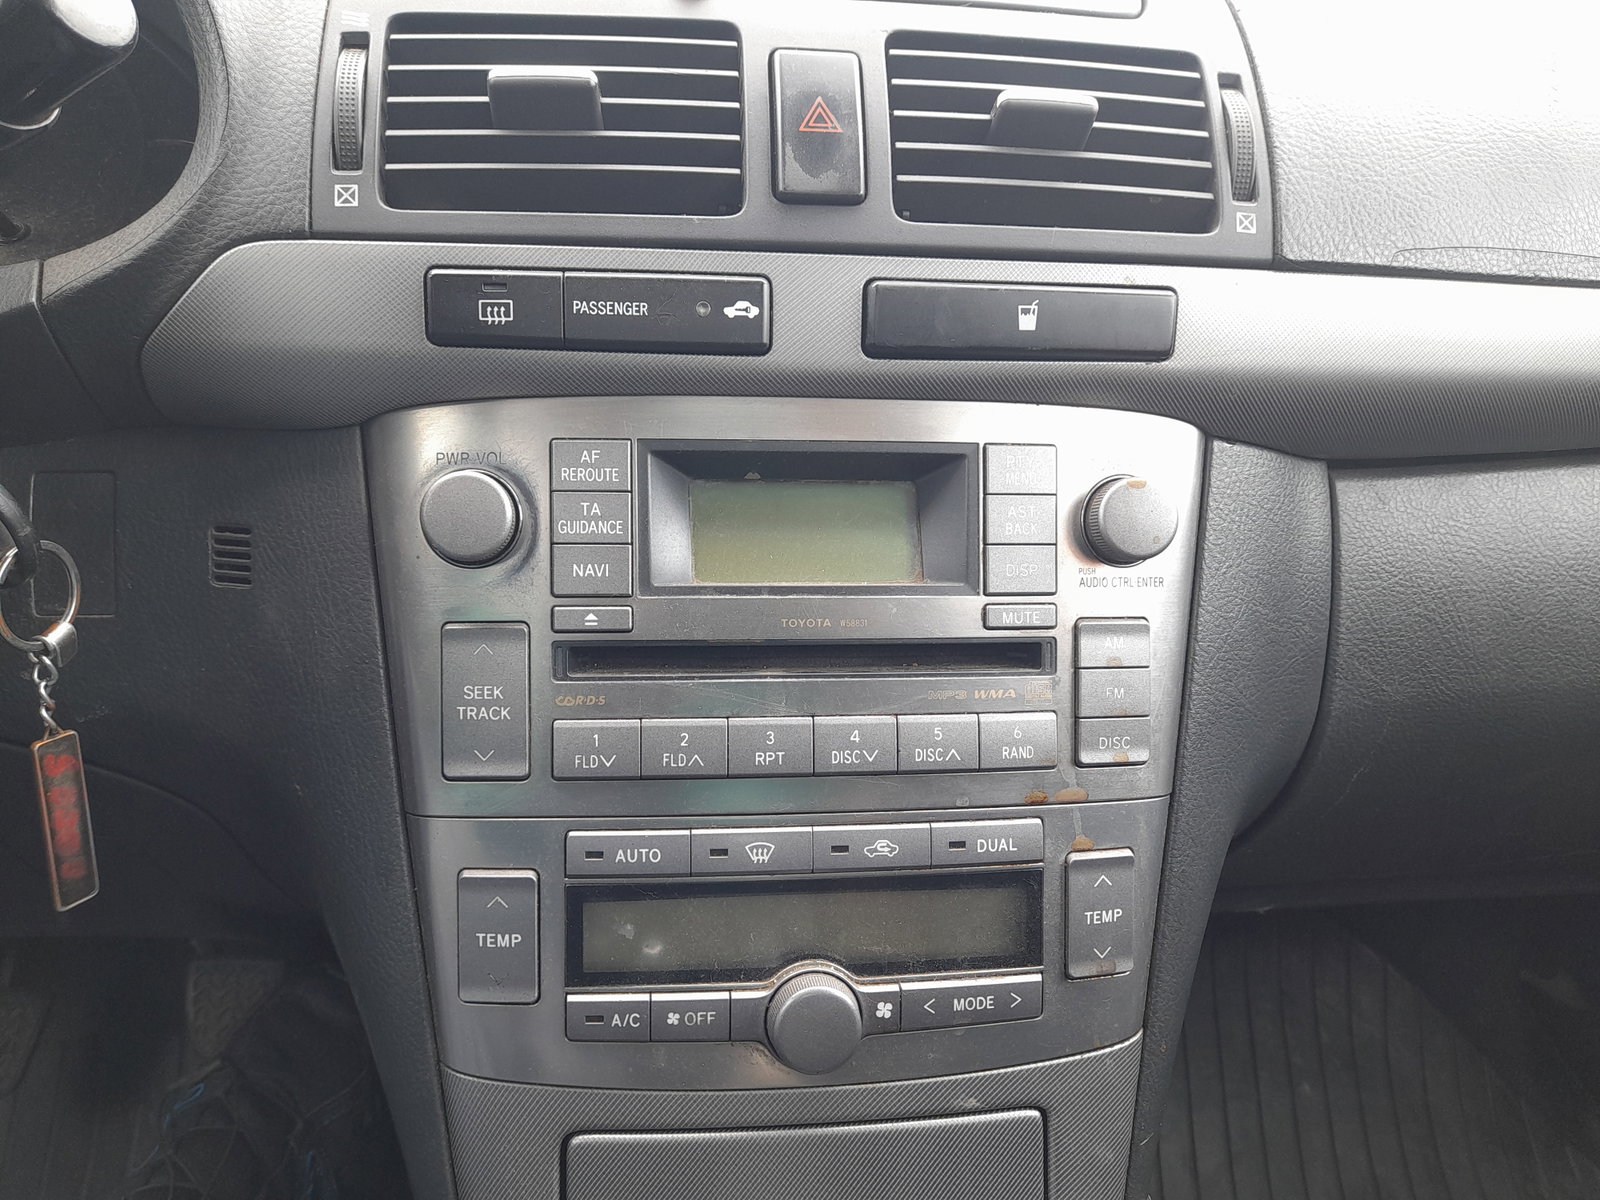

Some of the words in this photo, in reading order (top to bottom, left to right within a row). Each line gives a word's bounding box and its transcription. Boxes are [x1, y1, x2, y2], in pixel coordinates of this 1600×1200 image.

[572, 300, 649, 316] PASSENGER
[435, 452, 470, 466] PWR
[476, 451, 507, 466] VOL
[580, 450, 601, 464] AF
[561, 468, 620, 483] REROUTE
[580, 502, 601, 516] TA
[1007, 506, 1037, 518] AST
[557, 520, 624, 535] GUIDANCE
[1005, 523, 1039, 536] BACK
[572, 563, 610, 578] NAVI
[1006, 564, 1039, 577] DISP
[1078, 567, 1097, 576] PUSH
[1079, 577, 1109, 588] AUDIO
[1111, 577, 1134, 588] CTRL
[1137, 577, 1165, 588] ENTER
[780, 618, 832, 628] TOYOTA
[1002, 611, 1041, 624] MUTE
[1104, 637, 1124, 649] AM
[463, 685, 504, 700] SEEK
[927, 690, 968, 700] MP3
[974, 689, 1017, 700] WMA
[1106, 688, 1125, 699] FM
[456, 707, 511, 720] TRACK
[680, 732, 689, 747] 2
[765, 730, 775, 745] 3
[850, 729, 860, 744] 4
[933, 727, 943, 741] 5
[1013, 726, 1022, 739] 6
[592, 733, 600, 748] 1
[1099, 737, 1131, 749] DISC
[662, 752, 687, 767] FLD
[755, 751, 785, 766] RPT
[831, 750, 861, 765] DISC
[914, 748, 944, 762] DISC
[1002, 746, 1034, 760] RAND
[574, 754, 600, 769] FLD
[976, 837, 1018, 853] DUAL
[615, 848, 662, 863] AUTO
[1084, 908, 1123, 925] TEMP
[475, 933, 522, 948] TEMP
[953, 996, 995, 1012] MODE
[611, 1012, 641, 1028] A/C
[684, 1011, 716, 1026] OFF
